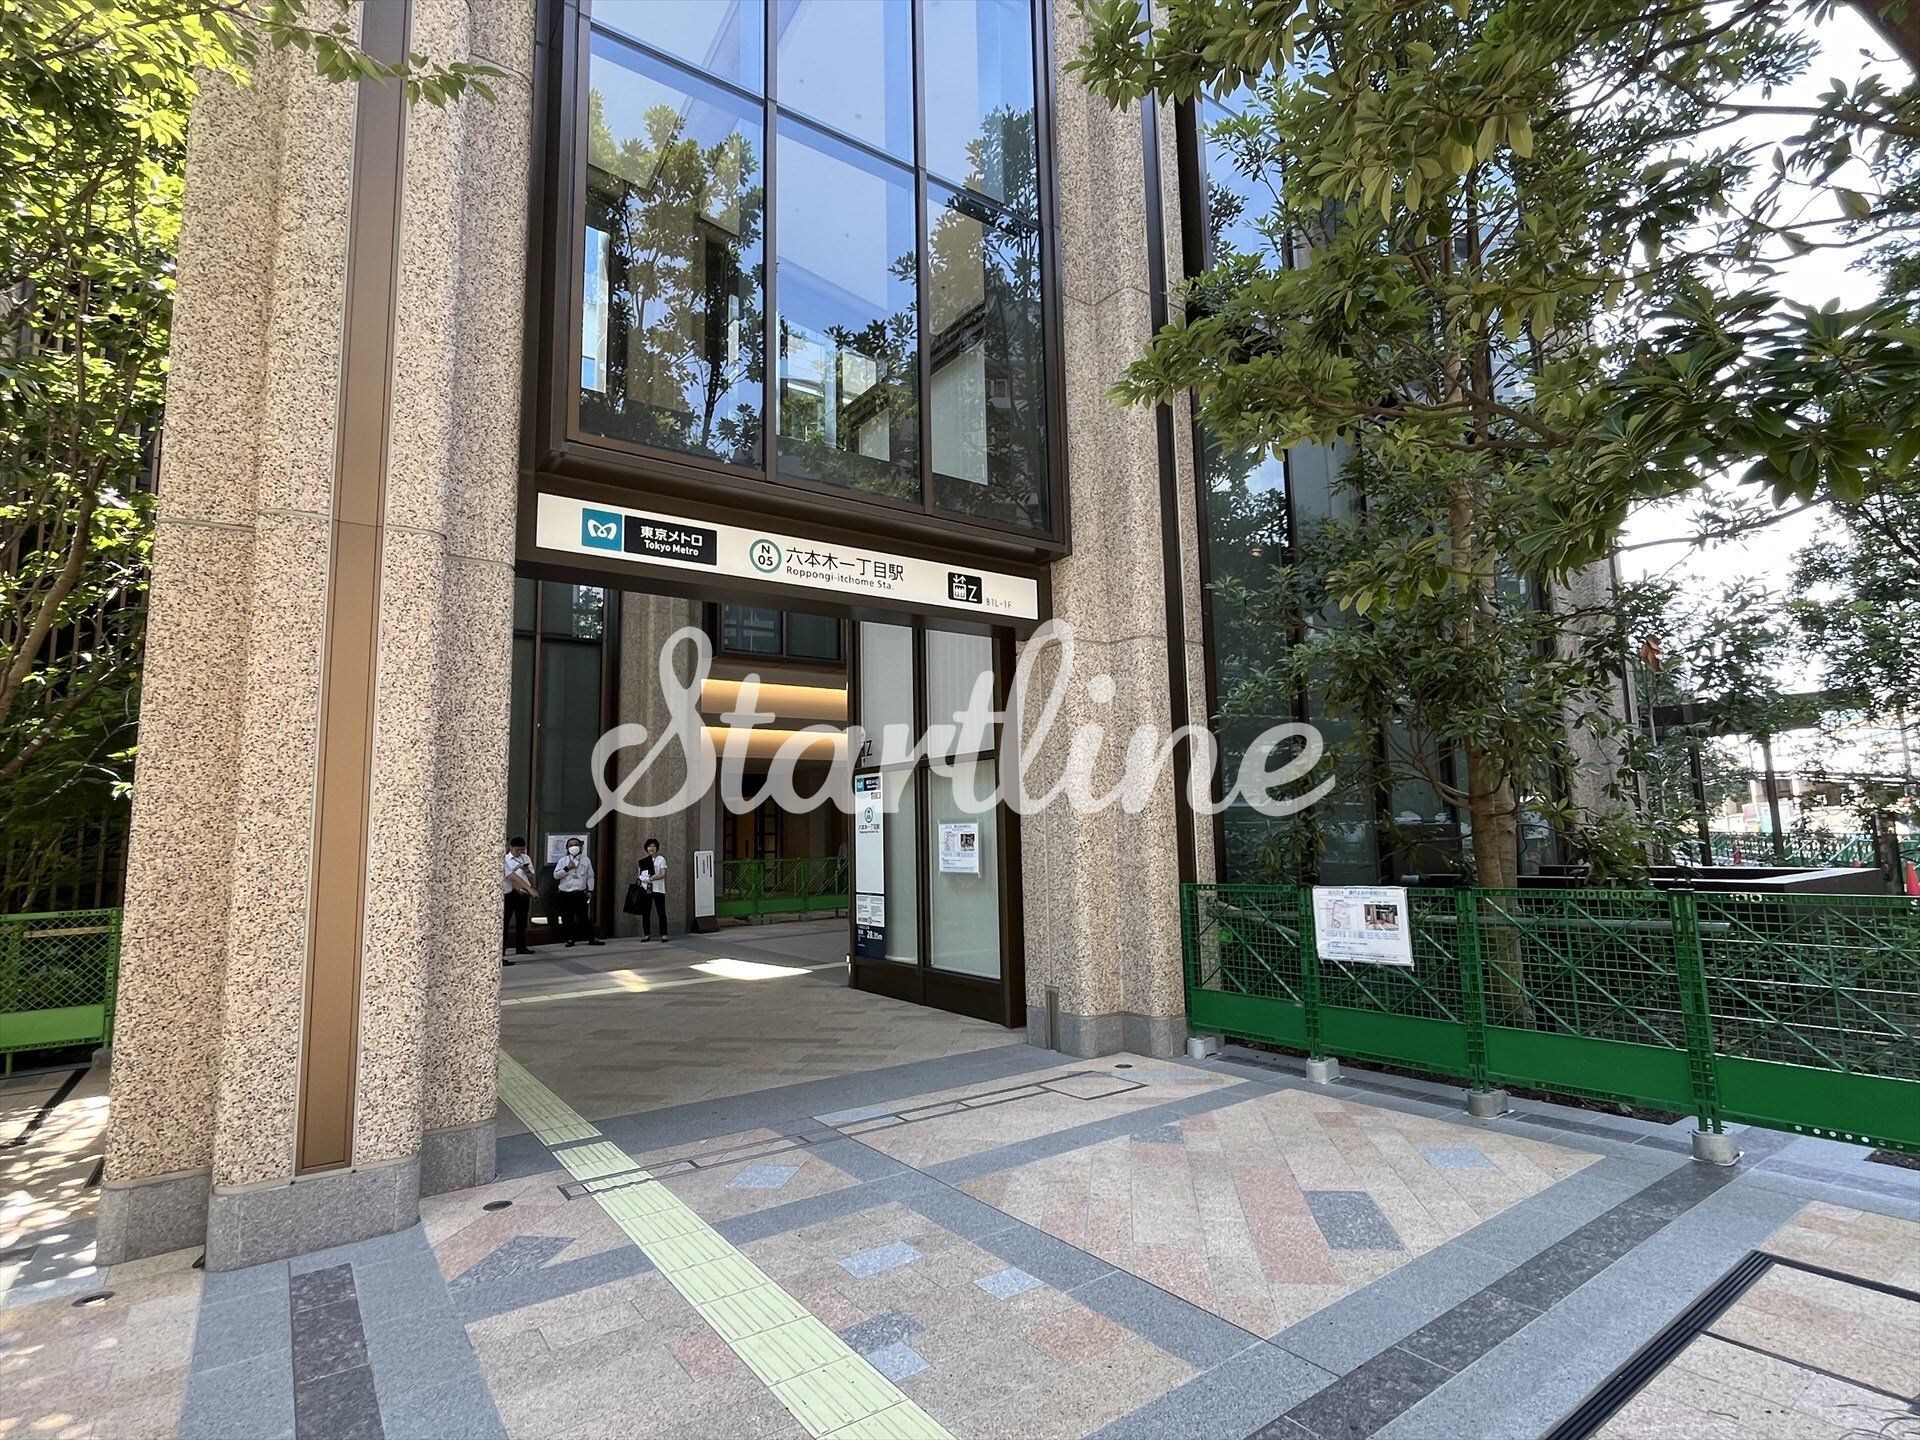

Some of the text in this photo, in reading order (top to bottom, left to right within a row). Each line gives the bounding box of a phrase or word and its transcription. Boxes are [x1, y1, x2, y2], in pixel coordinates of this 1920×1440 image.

[640, 526, 703, 547] 東京メトロ
[644, 539, 699, 556] Tokyo Metro
[761, 544, 770, 555] N
[758, 555, 774, 567] 05
[786, 547, 904, 581] 六本木一丁目駅
[786, 566, 895, 591] Roppongi-itchome Sta.
[967, 585, 978, 602] Z
